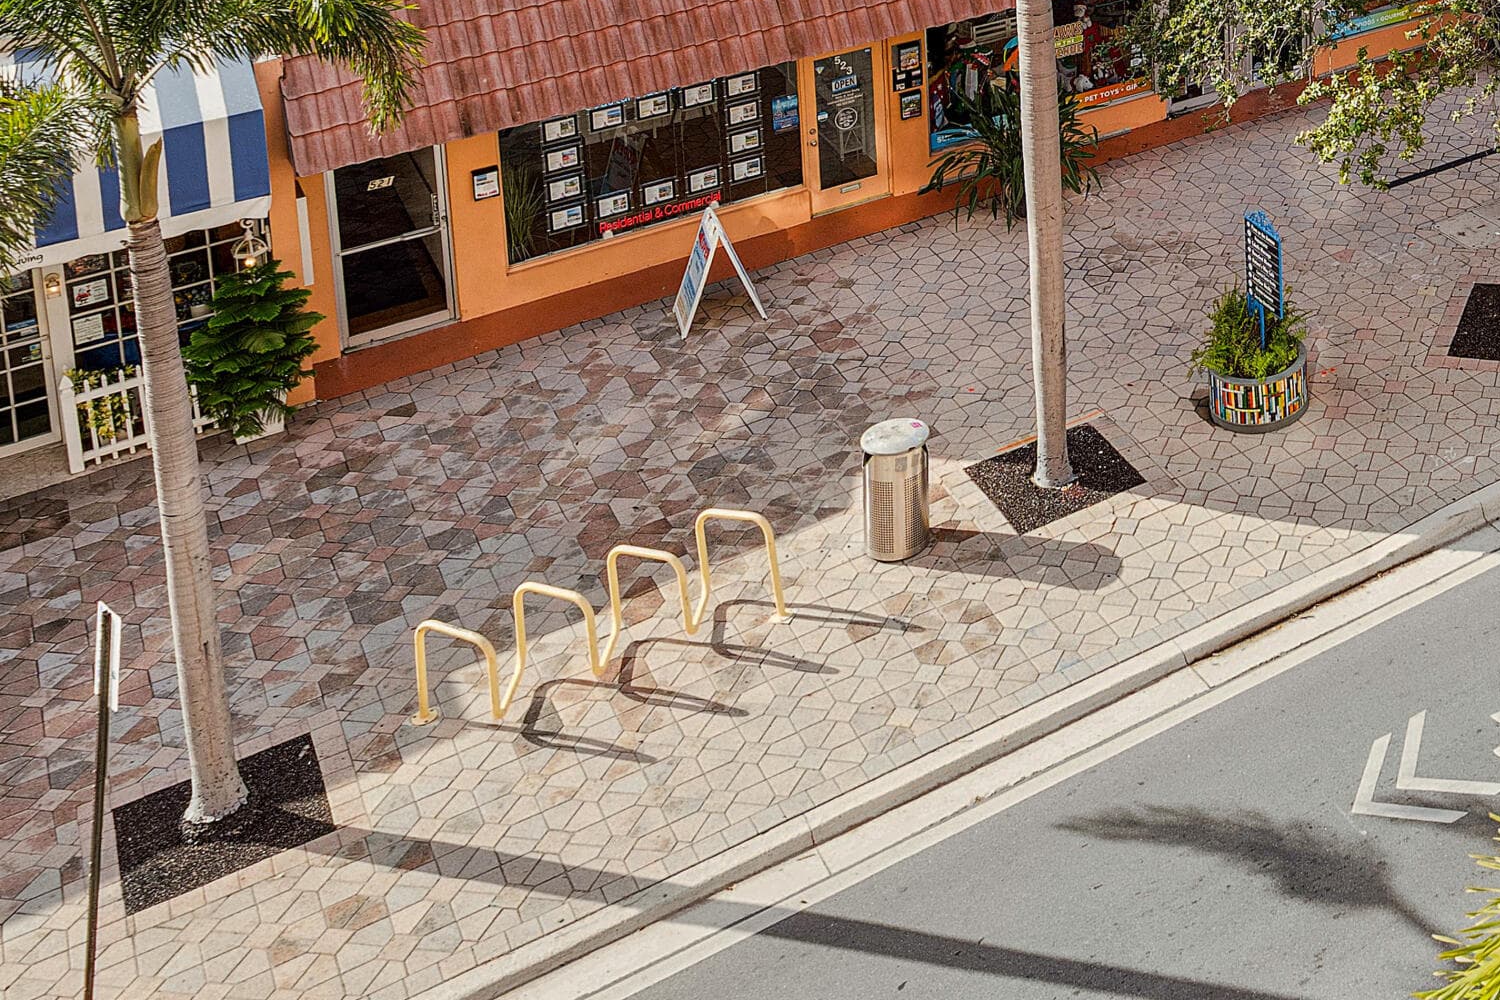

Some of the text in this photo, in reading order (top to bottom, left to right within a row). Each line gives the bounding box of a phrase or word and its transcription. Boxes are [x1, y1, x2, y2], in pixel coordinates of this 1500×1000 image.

[834, 56, 853, 75] 523
[834, 77, 855, 90] OPEN
[1084, 93, 1098, 102] PET
[1100, 88, 1120, 98] TOYS
[599, 190, 721, 233] Residential & Commercial
